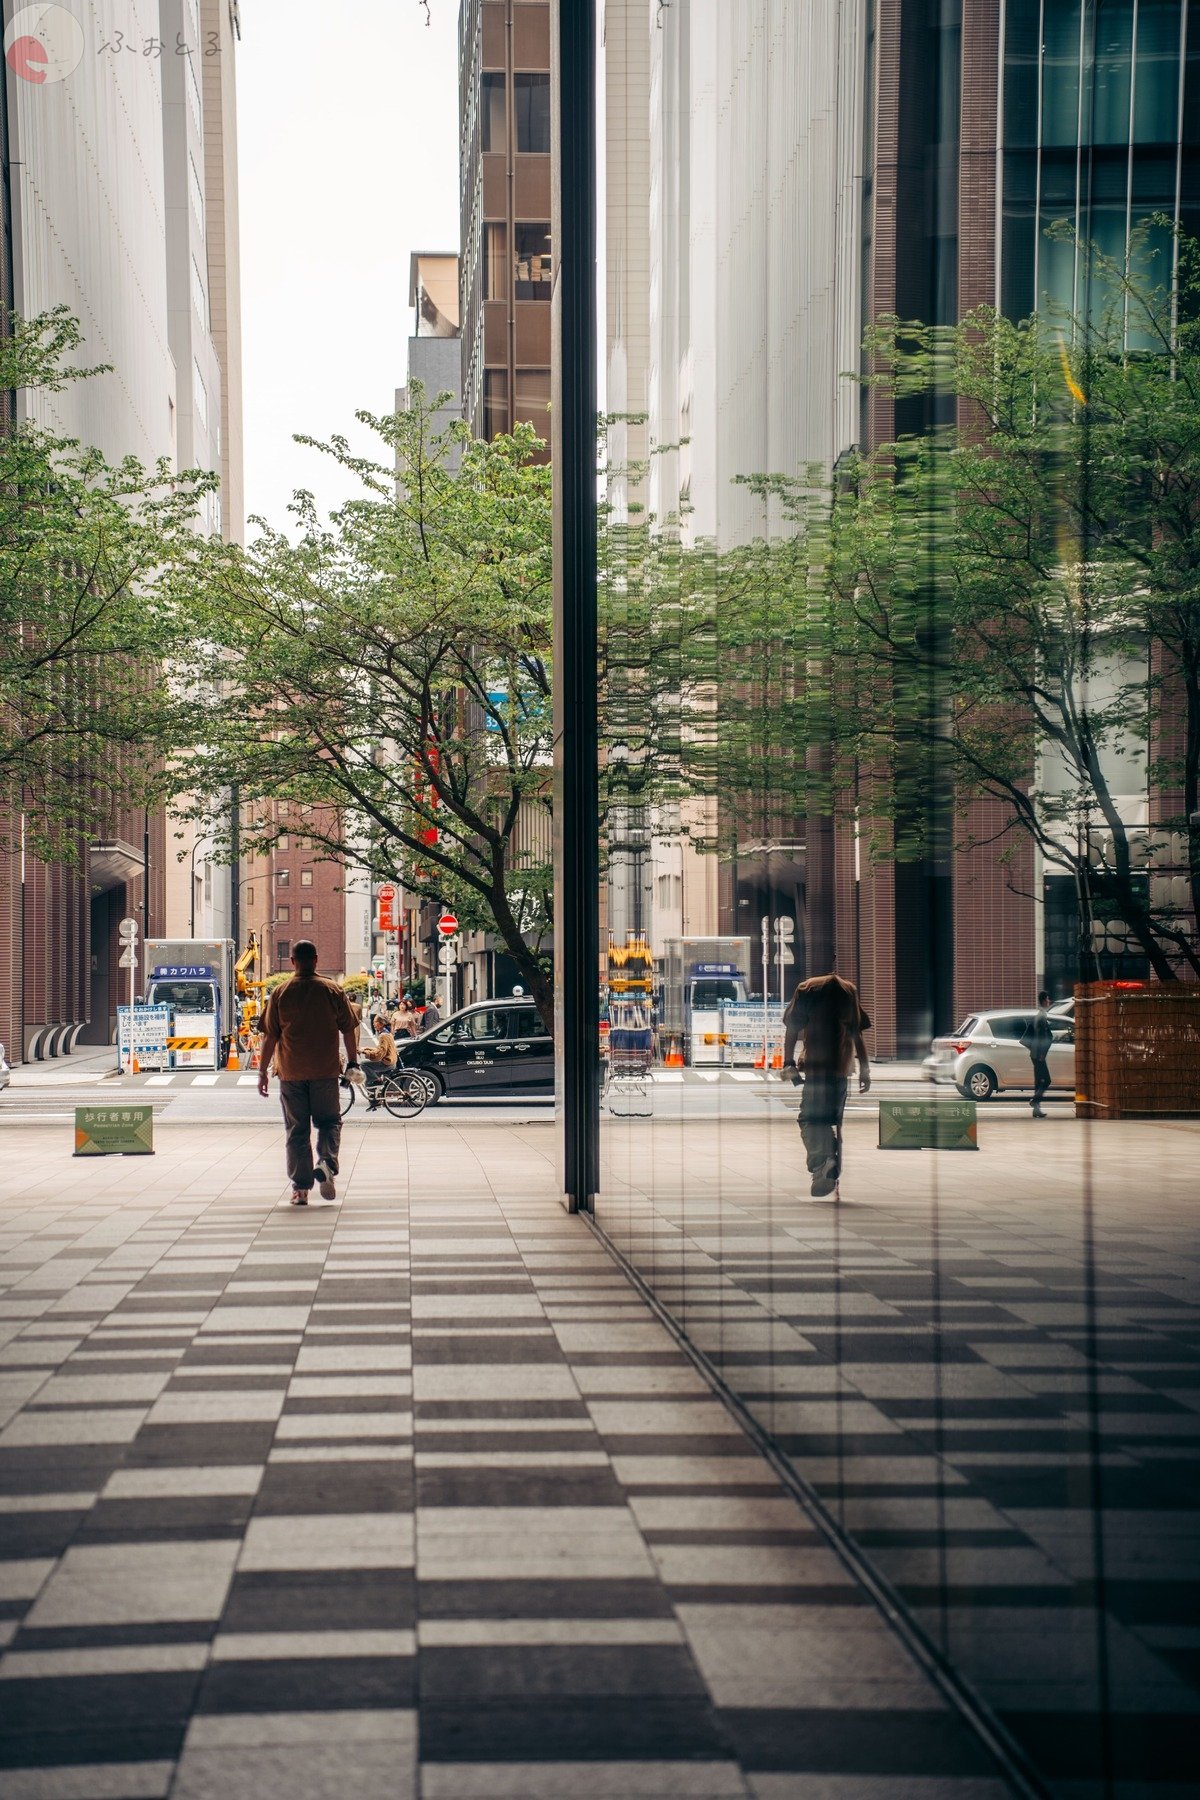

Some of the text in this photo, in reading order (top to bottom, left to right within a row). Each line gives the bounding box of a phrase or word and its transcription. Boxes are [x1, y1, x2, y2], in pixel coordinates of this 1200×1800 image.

[84, 1111, 144, 1122] 歩行者専用
